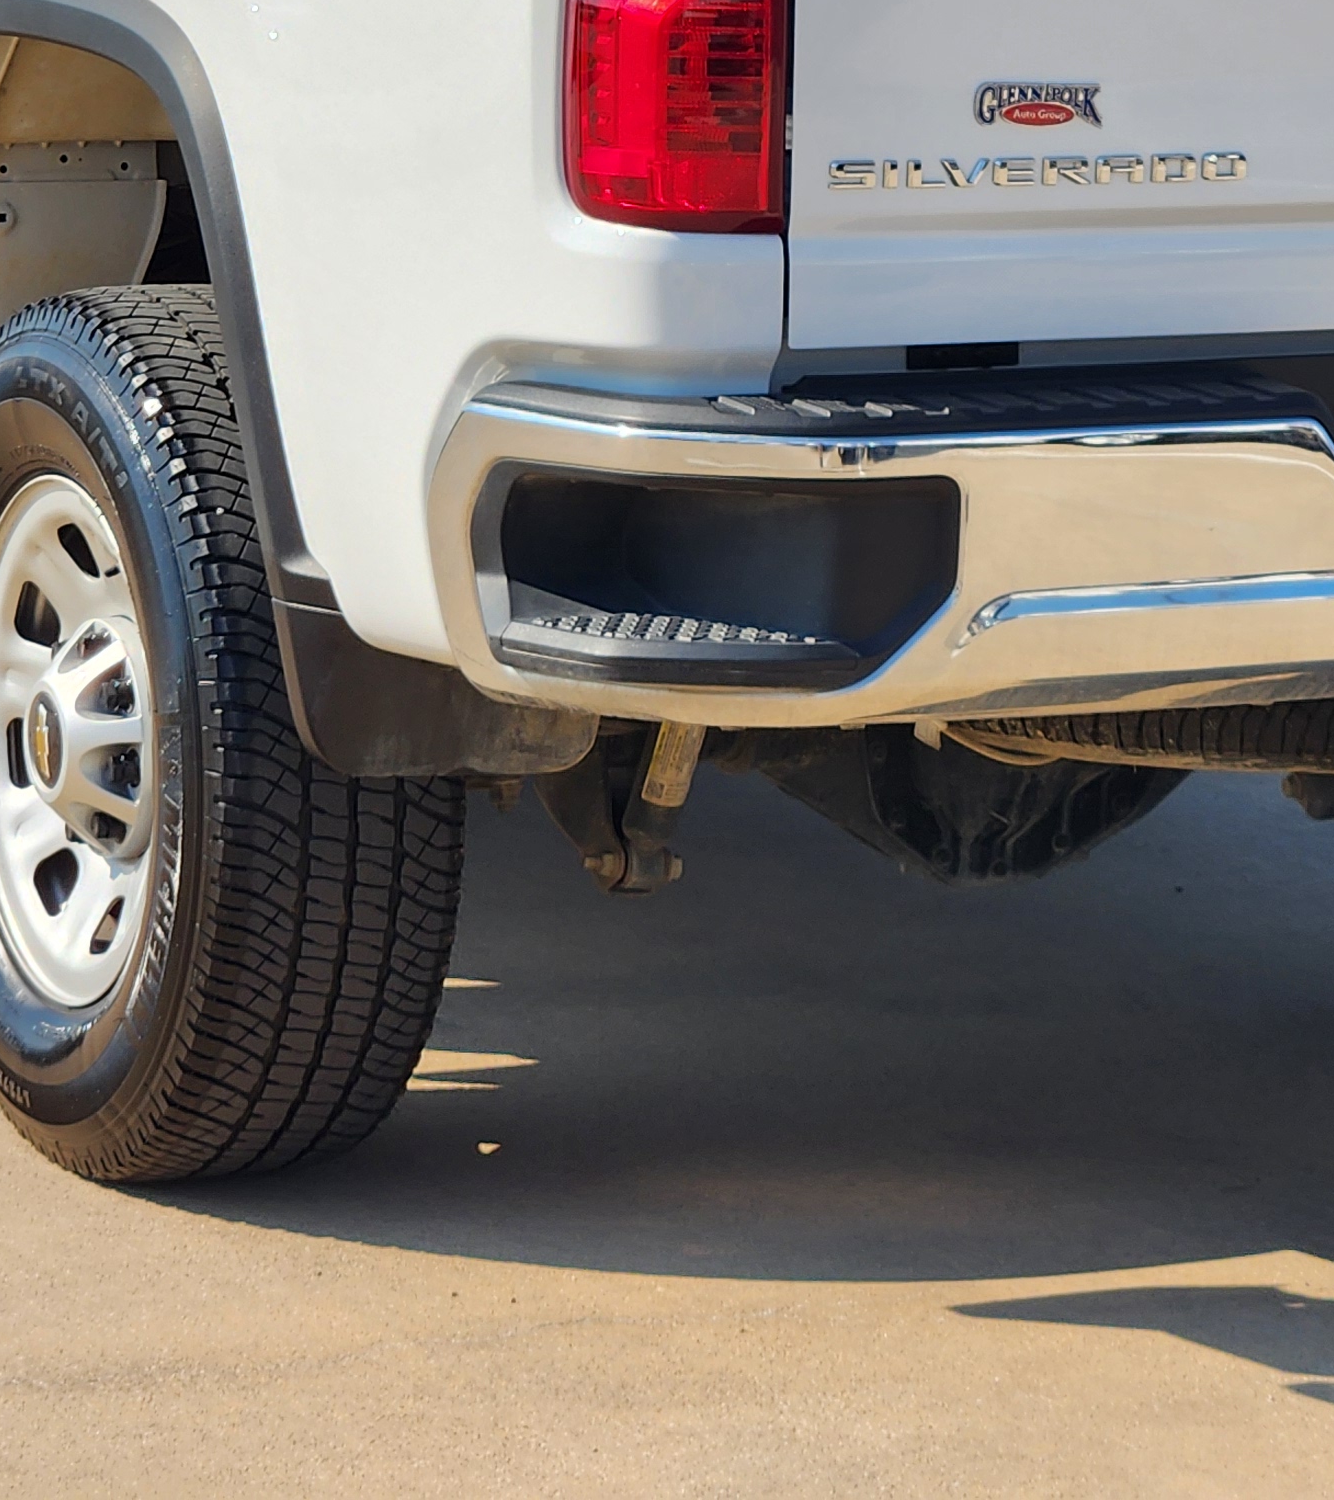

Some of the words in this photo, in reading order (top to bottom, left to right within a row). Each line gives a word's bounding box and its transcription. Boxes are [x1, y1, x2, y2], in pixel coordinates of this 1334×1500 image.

[1013, 109, 1036, 120] Auto
[1038, 109, 1067, 122] Group
[829, 151, 1248, 190] SILVERADO
